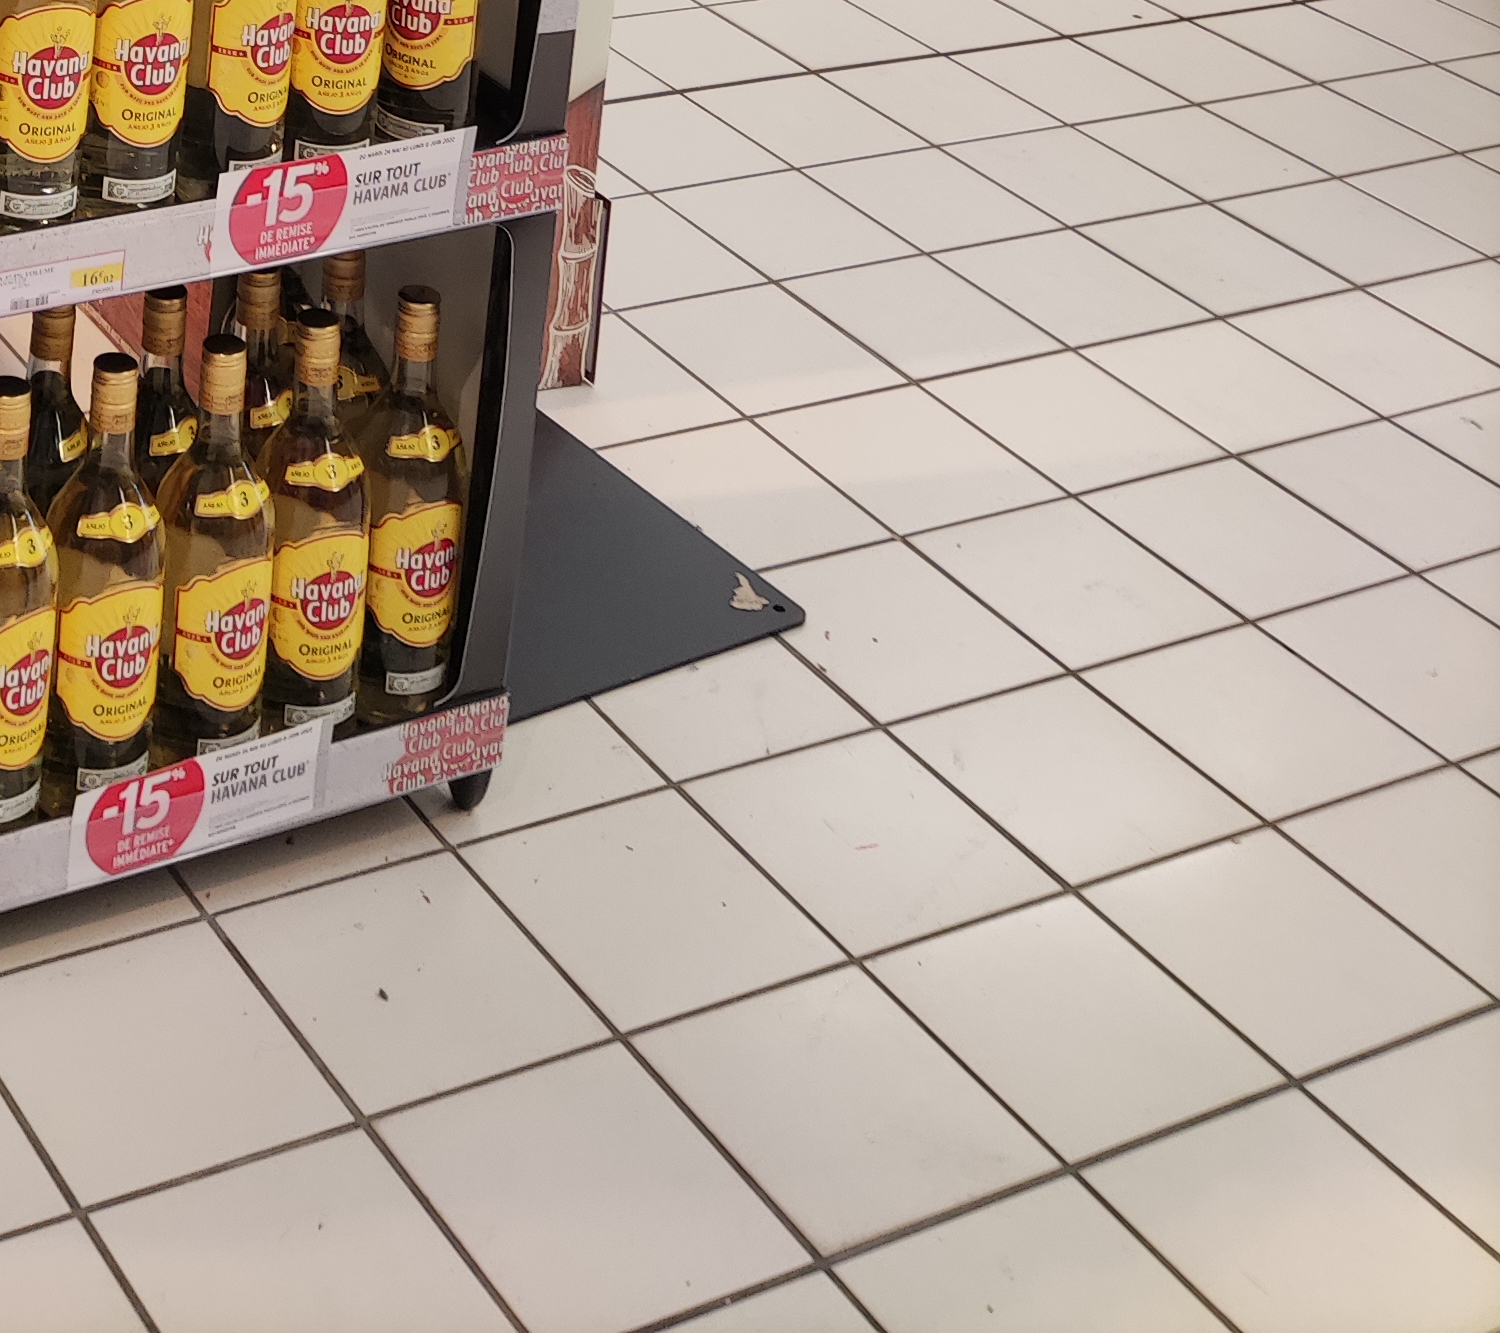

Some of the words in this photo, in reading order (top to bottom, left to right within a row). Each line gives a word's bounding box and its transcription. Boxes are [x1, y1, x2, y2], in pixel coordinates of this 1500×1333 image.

[306, 7, 380, 30] Havana
[320, 32, 366, 54] Club
[13, 51, 89, 76] Havana
[28, 76, 75, 100] Club
[355, 168, 382, 187] SUR
[386, 163, 419, 179] TOUT
[353, 182, 409, 206] HAVANA
[86, 626, 158, 658] Havana
[101, 657, 146, 681] Club
